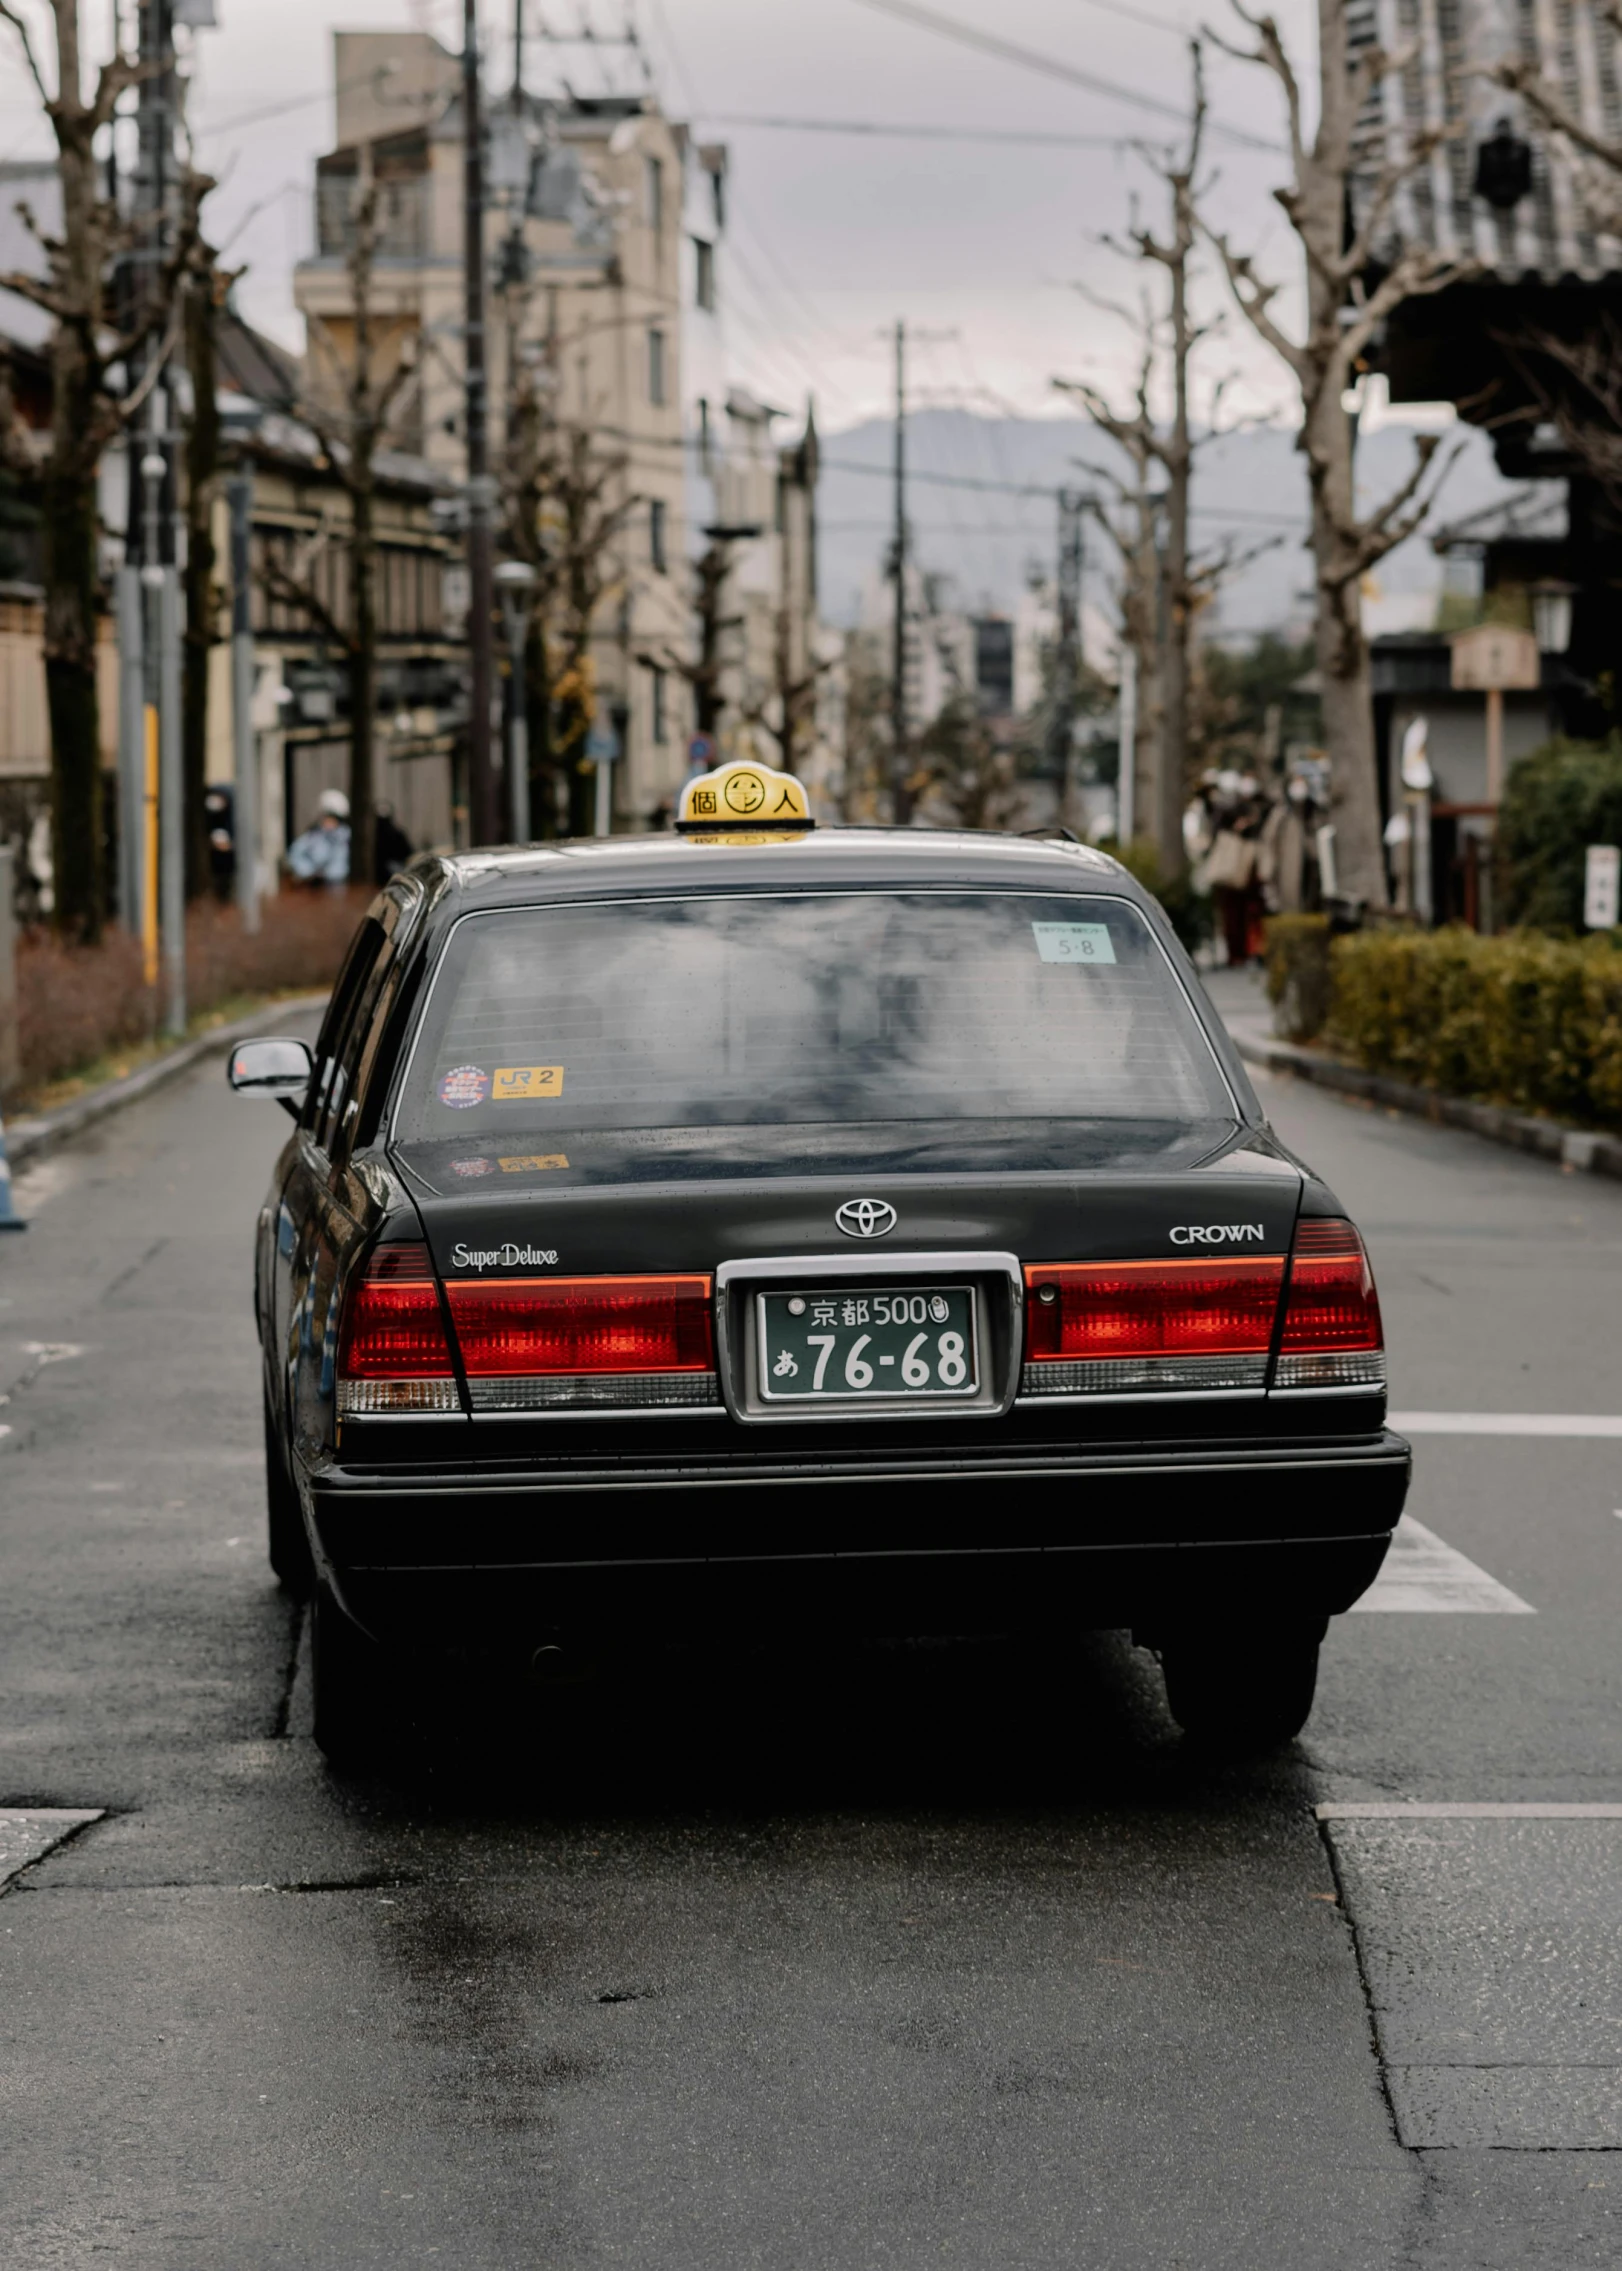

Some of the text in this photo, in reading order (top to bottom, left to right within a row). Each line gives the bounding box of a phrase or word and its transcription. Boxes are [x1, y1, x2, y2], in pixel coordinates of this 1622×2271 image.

[692, 789, 798, 815] 個 人
[500, 1070, 554, 1086] JR 2
[1169, 1224, 1265, 1245] CROWN
[773, 1331, 967, 1390] あ 76-68
